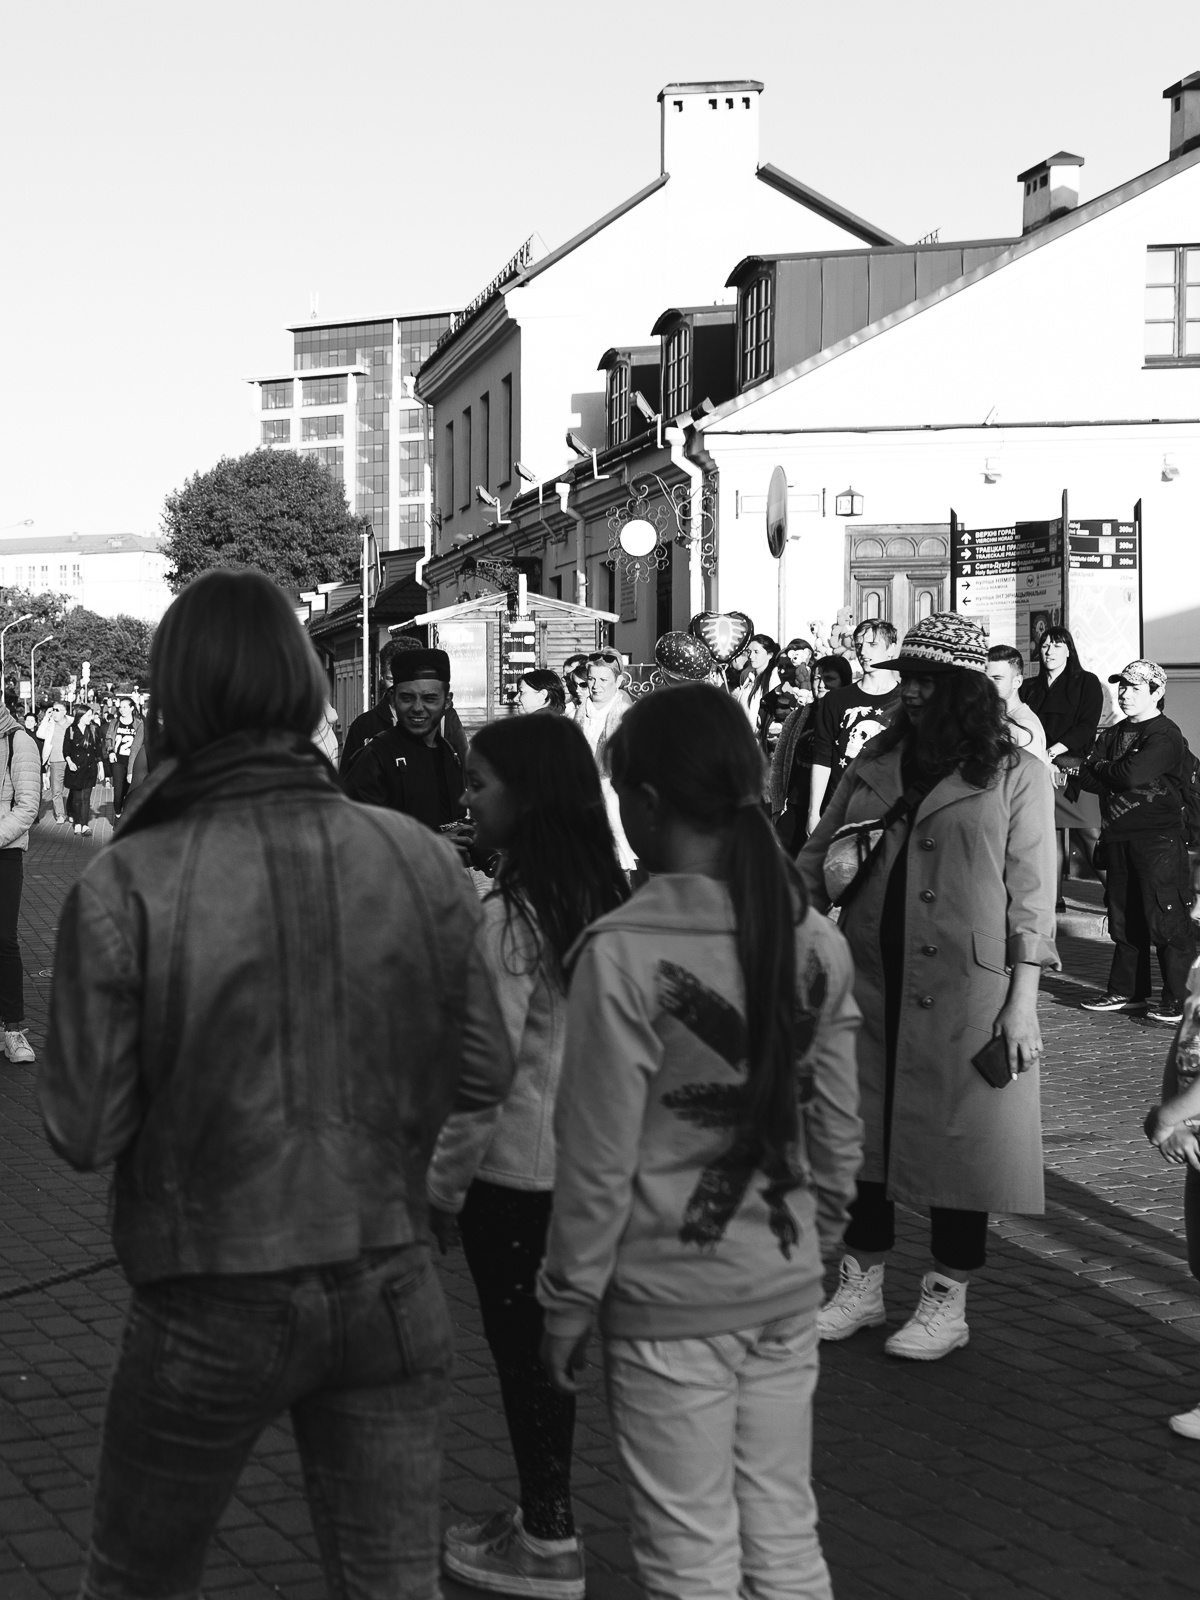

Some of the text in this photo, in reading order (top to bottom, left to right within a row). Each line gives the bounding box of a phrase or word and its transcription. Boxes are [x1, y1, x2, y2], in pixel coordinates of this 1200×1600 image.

[998, 528, 1016, 536] ГОРАД
[975, 545, 1005, 554] ТРАЕЦКАЕ
[975, 552, 1005, 560] TRAJECKAJE
